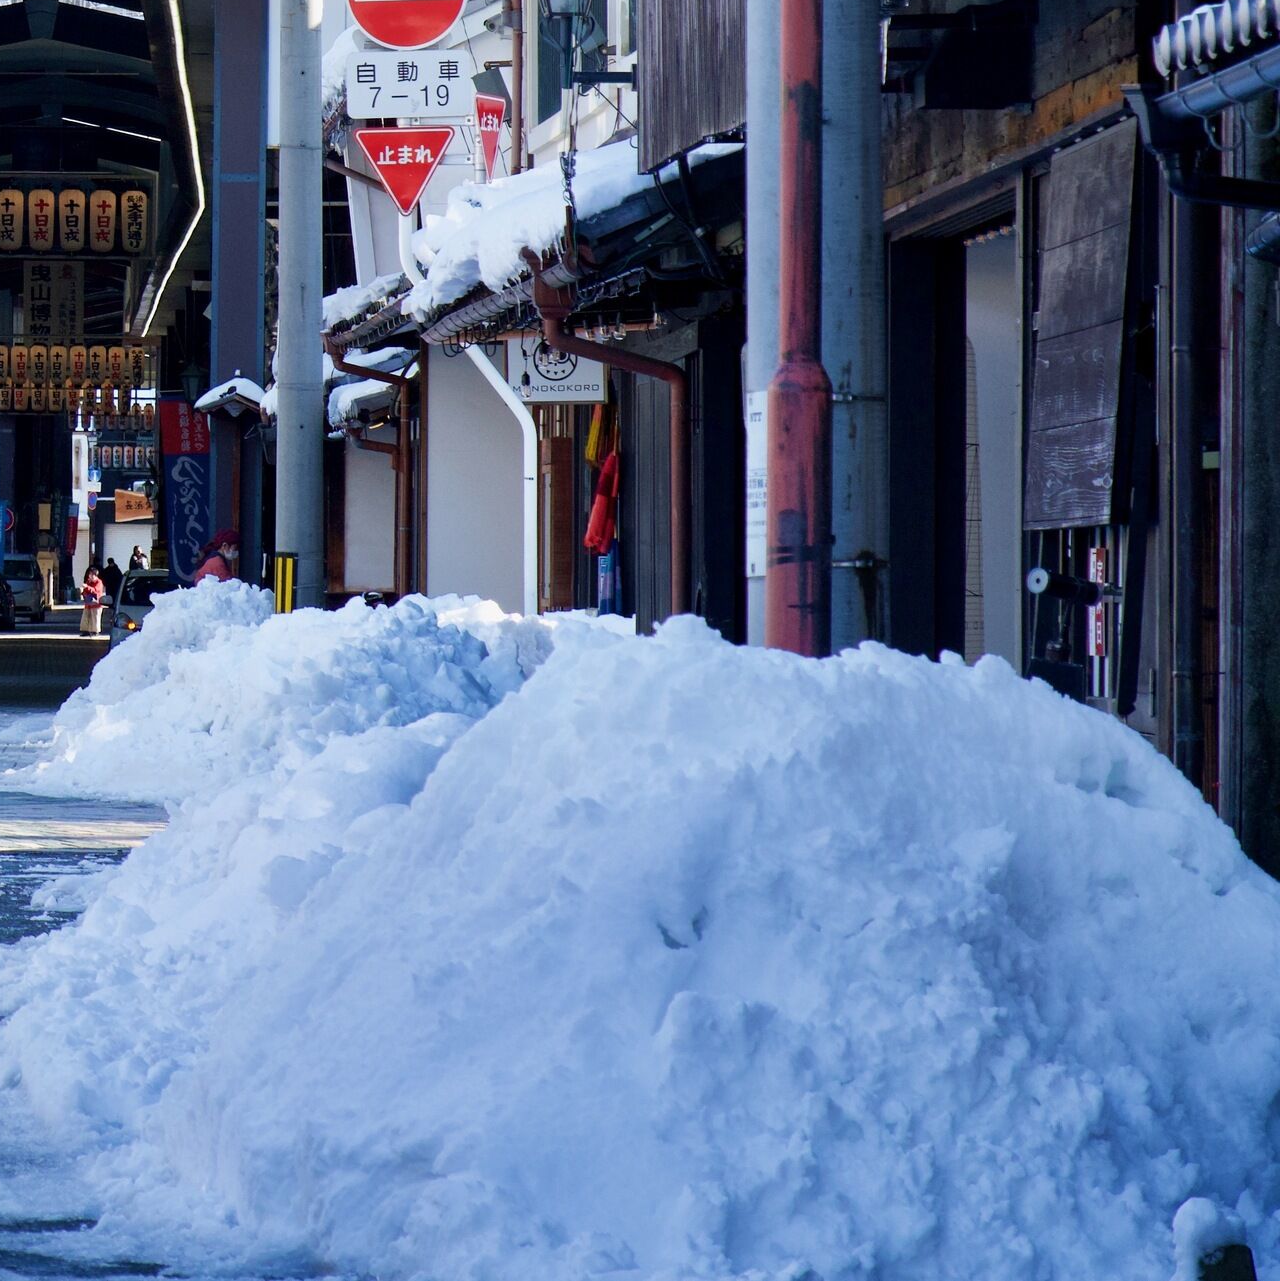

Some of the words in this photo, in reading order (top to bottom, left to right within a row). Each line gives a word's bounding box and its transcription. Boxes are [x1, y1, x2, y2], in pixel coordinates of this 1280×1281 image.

[356, 61, 460, 84] 自動車
[479, 113, 499, 132] 止まれ
[377, 146, 435, 166] 止まれ
[0, 198, 15, 241] 十日戎
[34, 199, 49, 242] 十日戎
[64, 199, 80, 242] 十日戎
[96, 200, 112, 243] 十日戎
[31, 265, 51, 340] 曳山博物
[512, 384, 600, 393] MNOKOKORO
